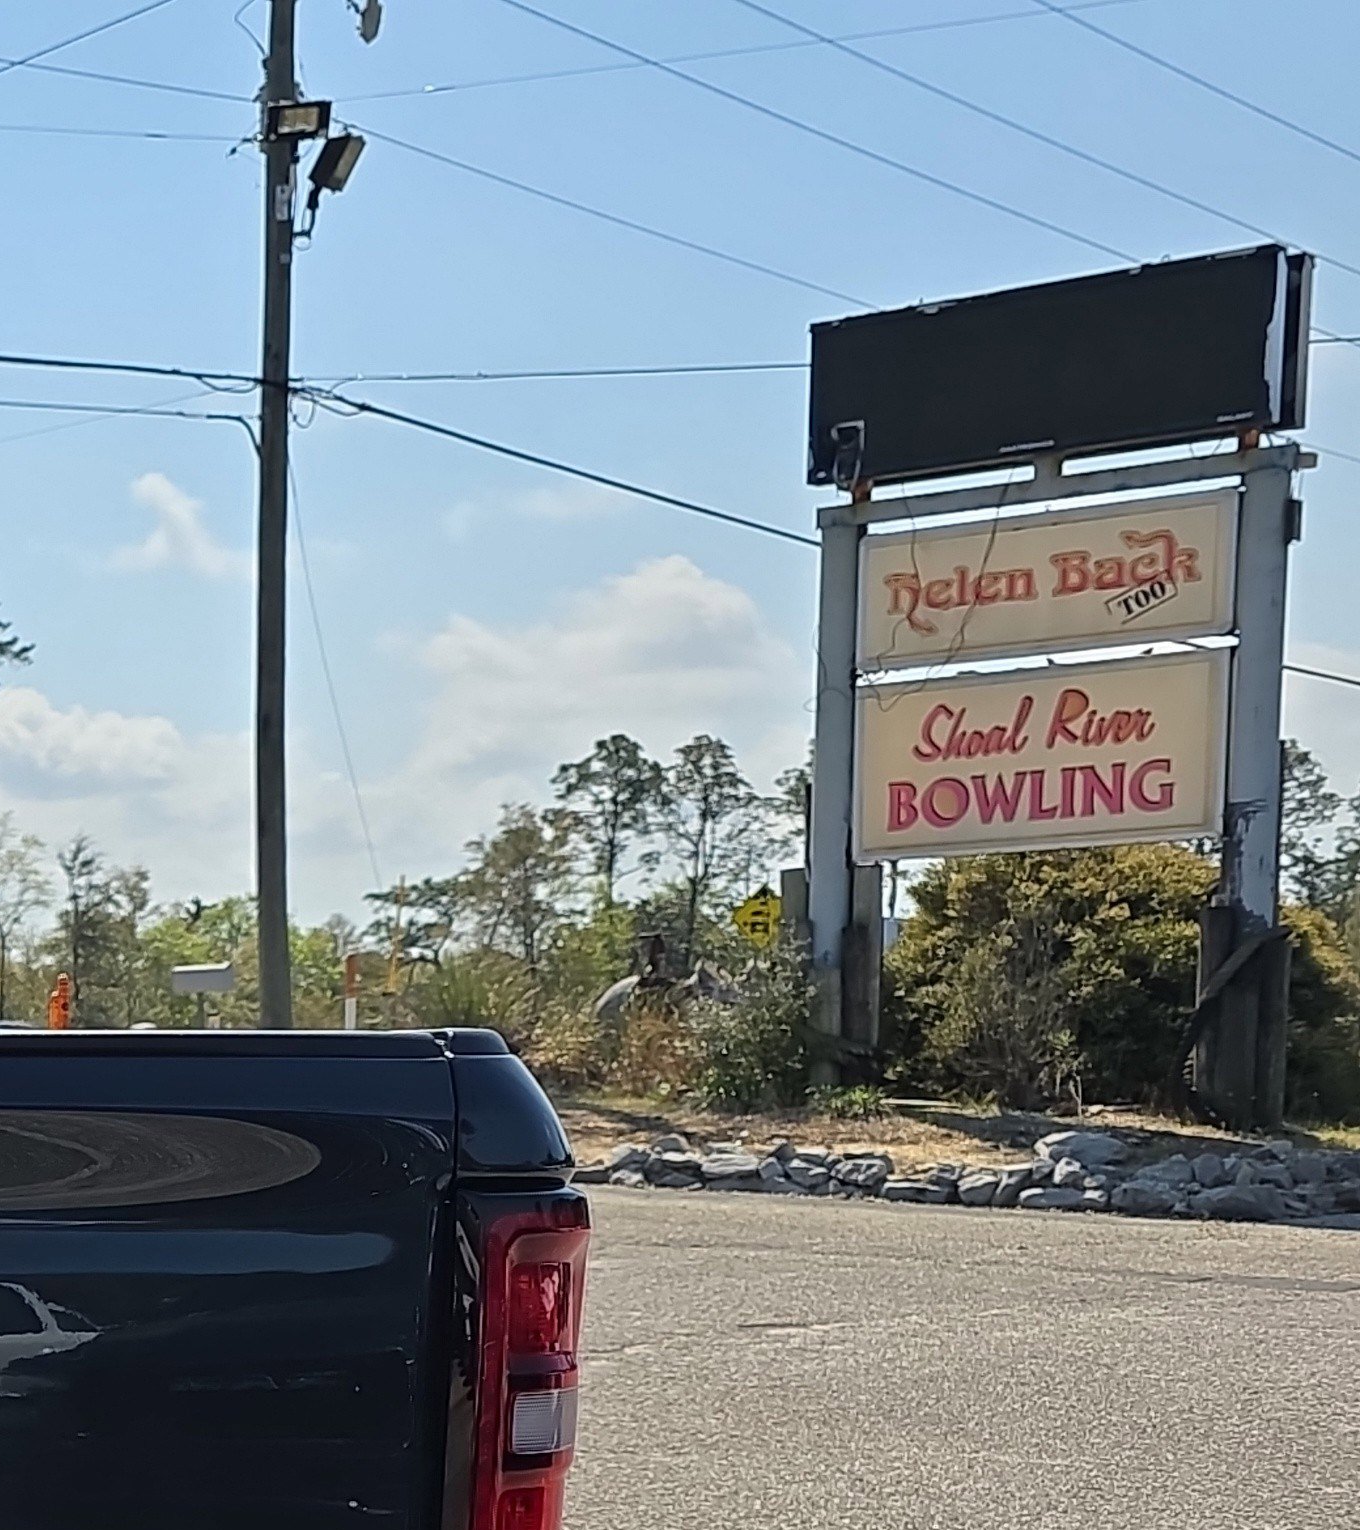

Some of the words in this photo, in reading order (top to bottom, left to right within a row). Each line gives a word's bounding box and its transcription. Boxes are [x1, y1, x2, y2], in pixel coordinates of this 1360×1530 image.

[1049, 529, 1203, 598] Back
[1115, 579, 1168, 618] TOO
[913, 695, 1034, 763] Shoal
[1045, 687, 1158, 750] River
[887, 758, 1176, 832] BOWLING
